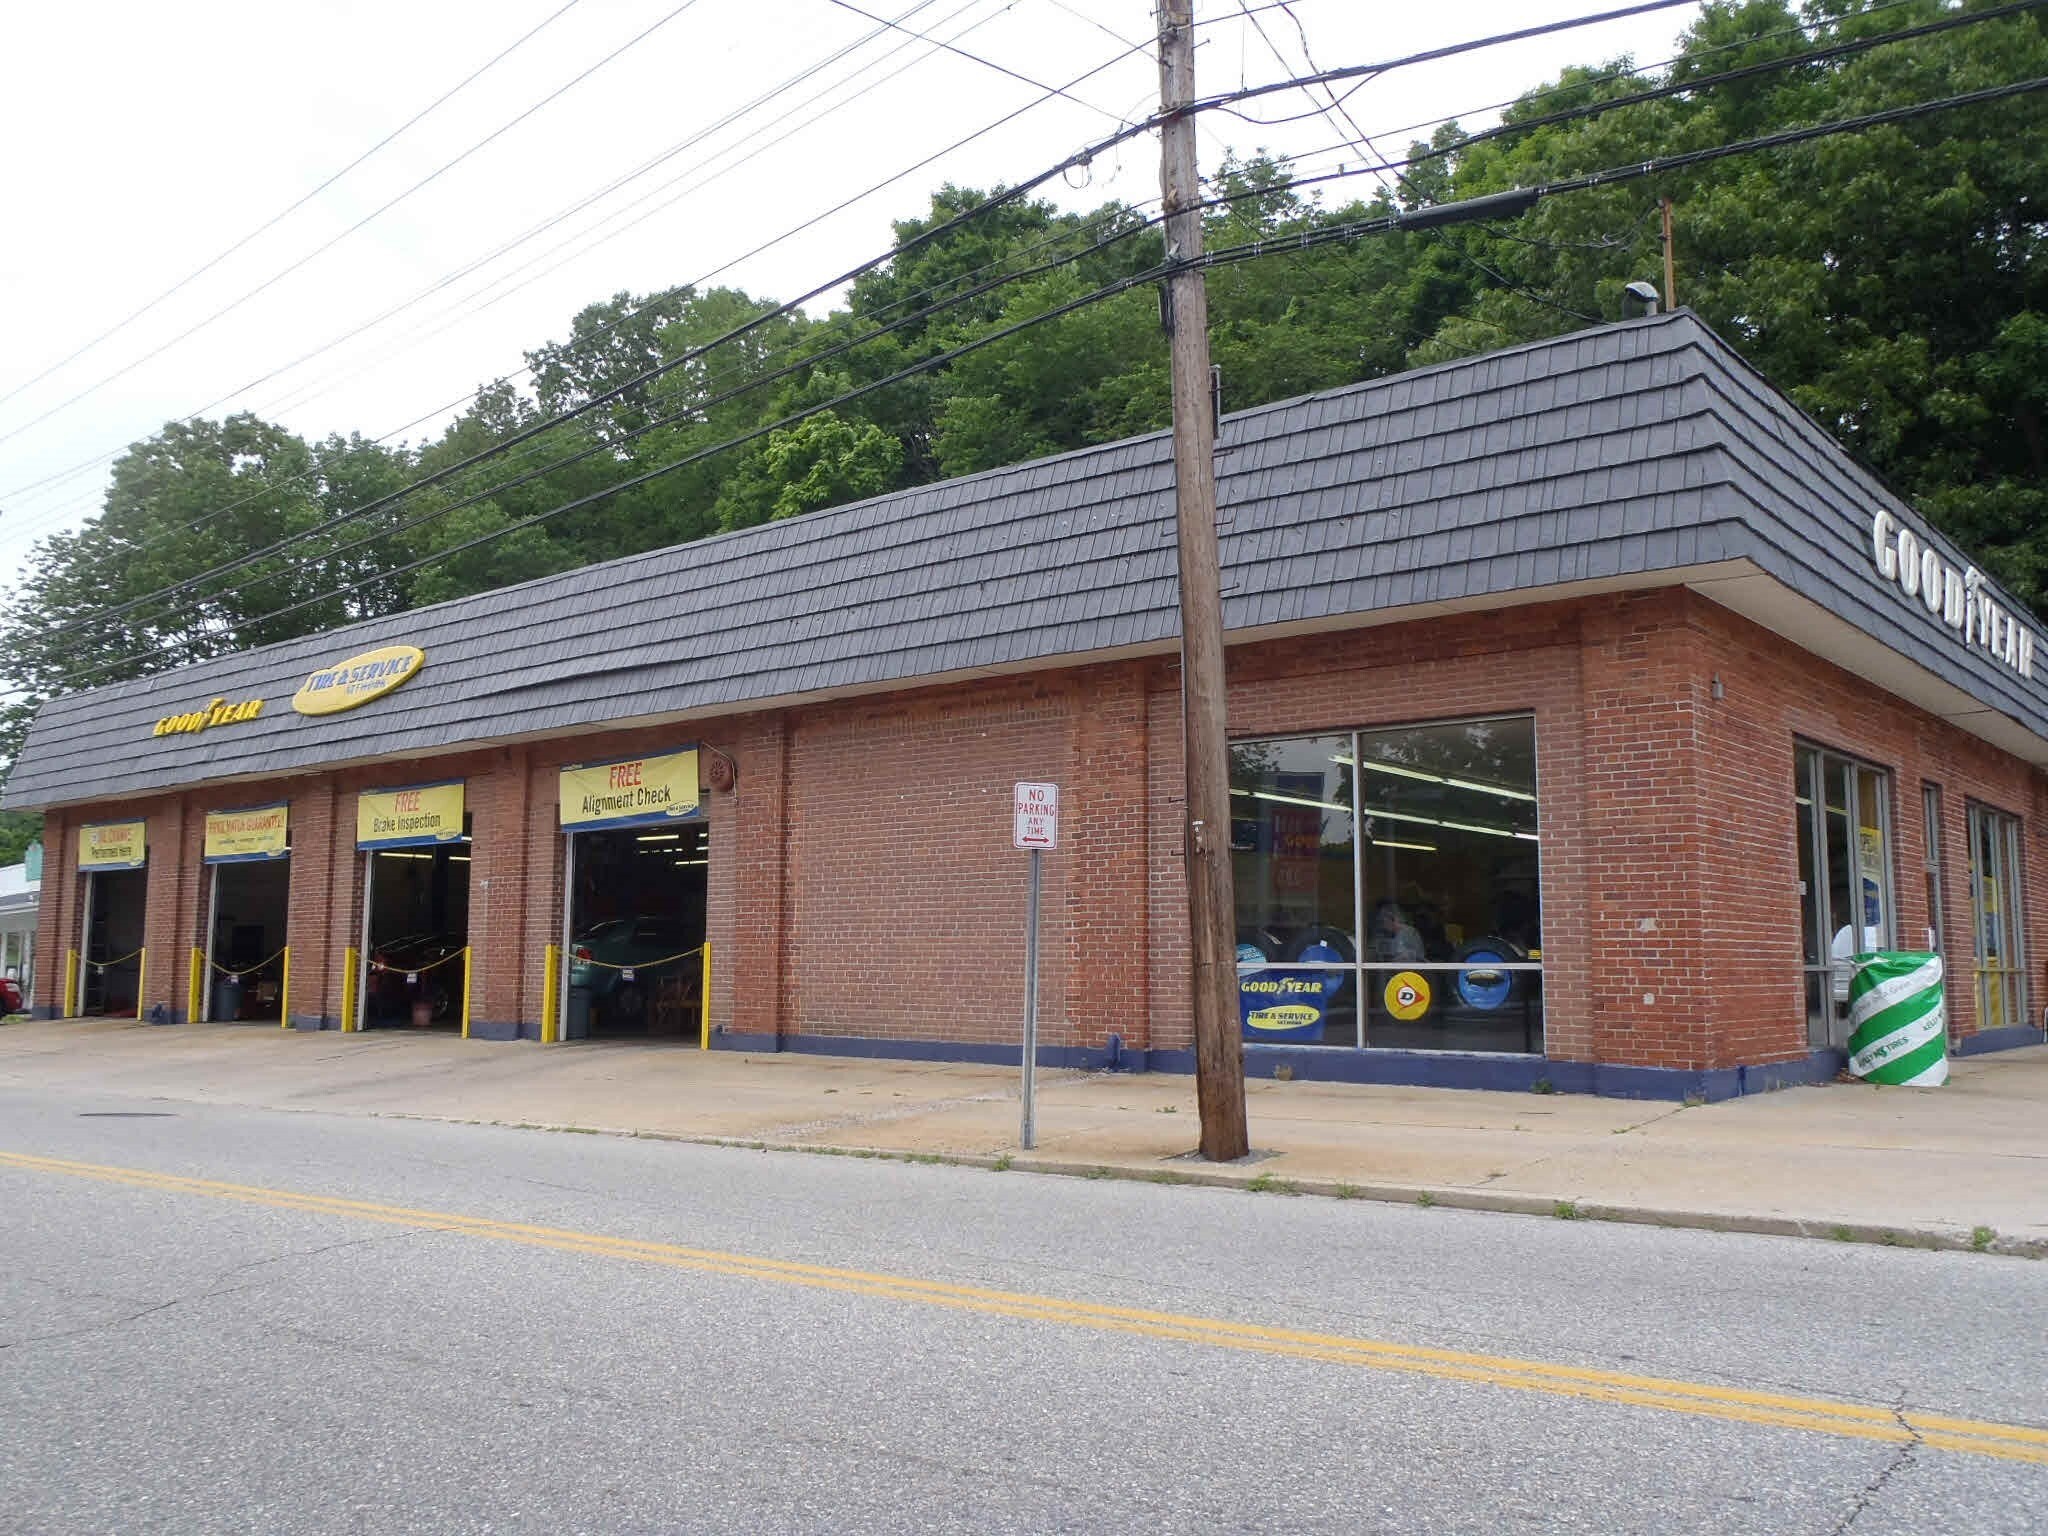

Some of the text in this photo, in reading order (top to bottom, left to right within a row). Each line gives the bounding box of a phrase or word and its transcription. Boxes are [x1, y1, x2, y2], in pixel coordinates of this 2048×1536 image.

[306, 672, 337, 693] TIRE
[350, 656, 413, 683] SERVICE
[610, 762, 643, 789] FREE
[395, 791, 421, 813] FREE
[582, 784, 671, 815] Alignment Check
[1029, 789, 1044, 802] NO
[1018, 802, 1055, 816] PARKING
[373, 811, 441, 832] Brake Inspection
[1028, 816, 1045, 826] ANY
[1026, 826, 1045, 835] TIME
[1399, 991, 1414, 1001] D
[1250, 1011, 1270, 1019] TIRE
[1278, 1012, 1313, 1020] SERVICE
